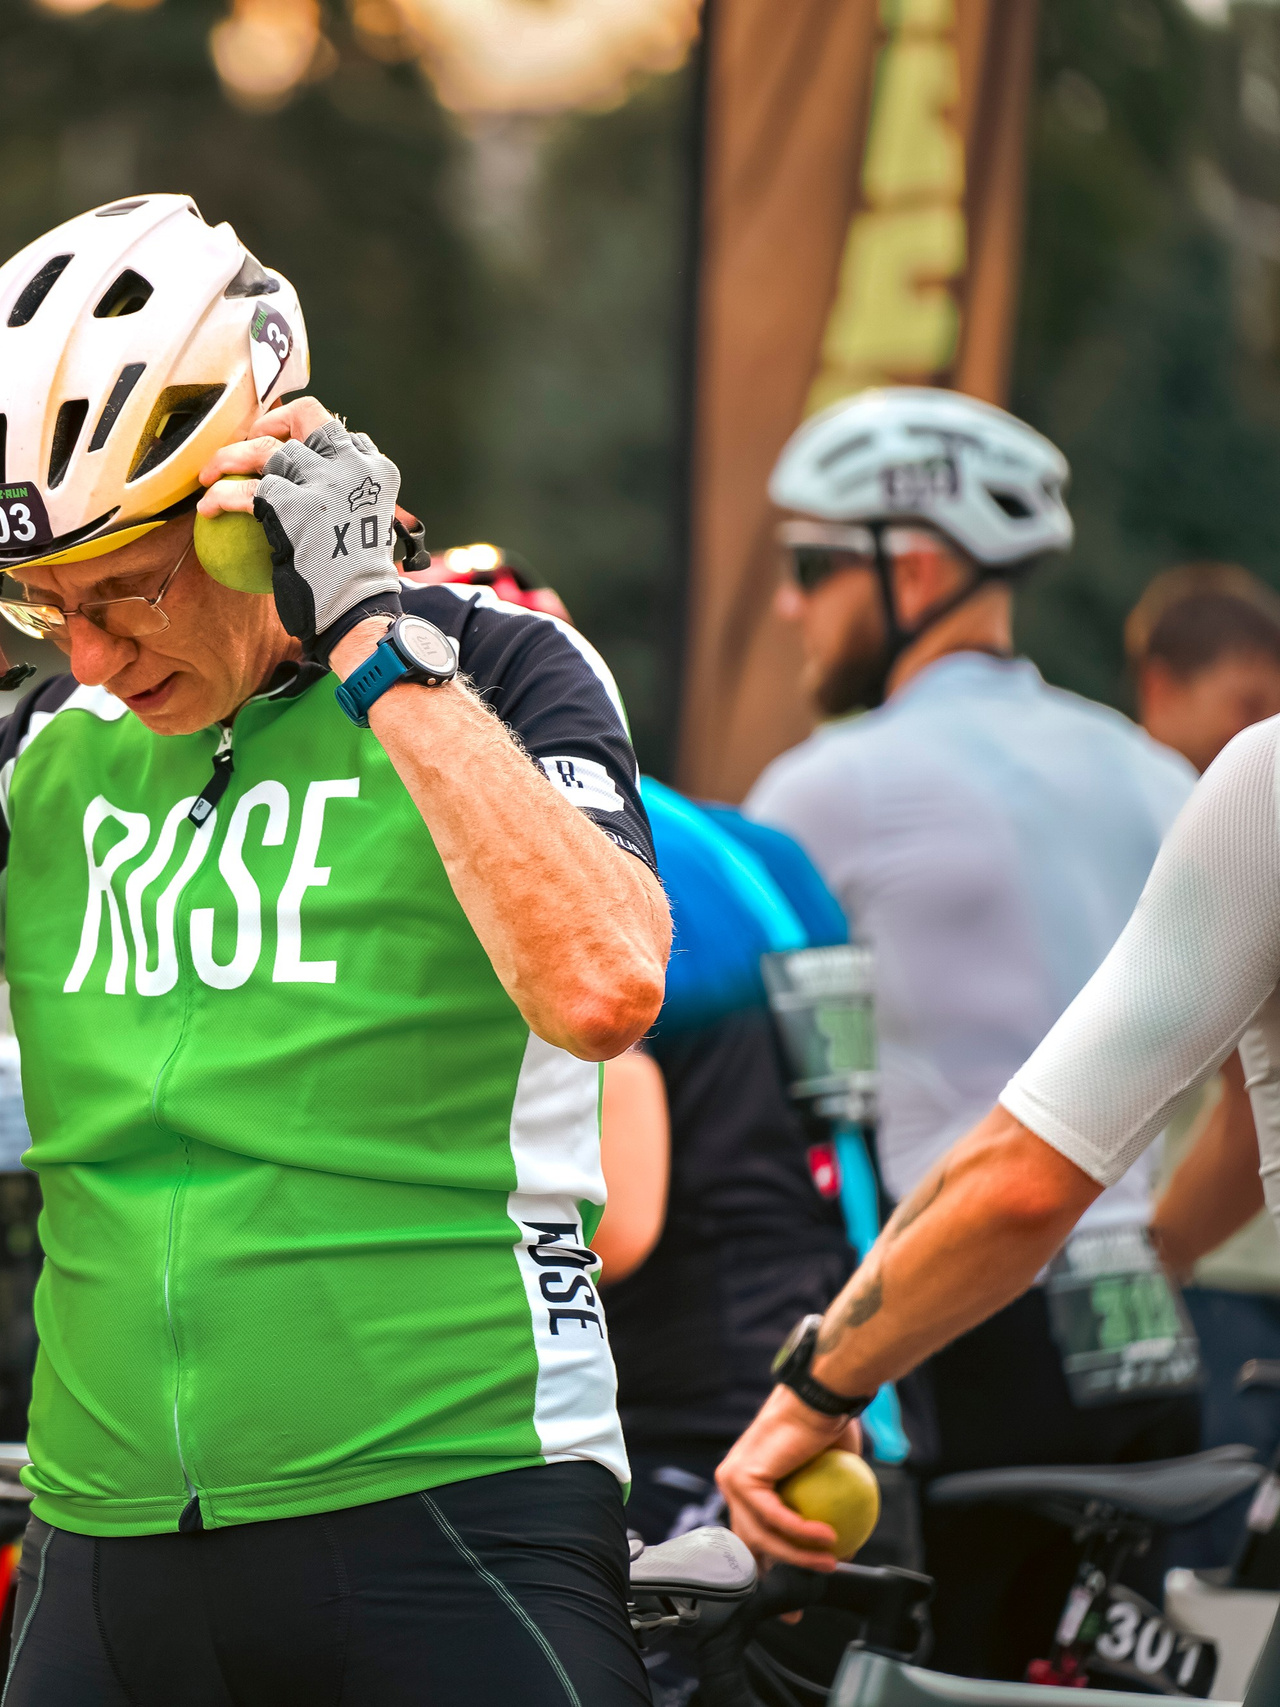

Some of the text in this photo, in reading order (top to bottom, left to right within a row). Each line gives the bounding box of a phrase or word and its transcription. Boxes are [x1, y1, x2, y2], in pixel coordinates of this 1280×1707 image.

[63, 777, 360, 997] ROSE
[521, 1220, 604, 1340] ROSE
[1095, 1600, 1204, 1688] 301
